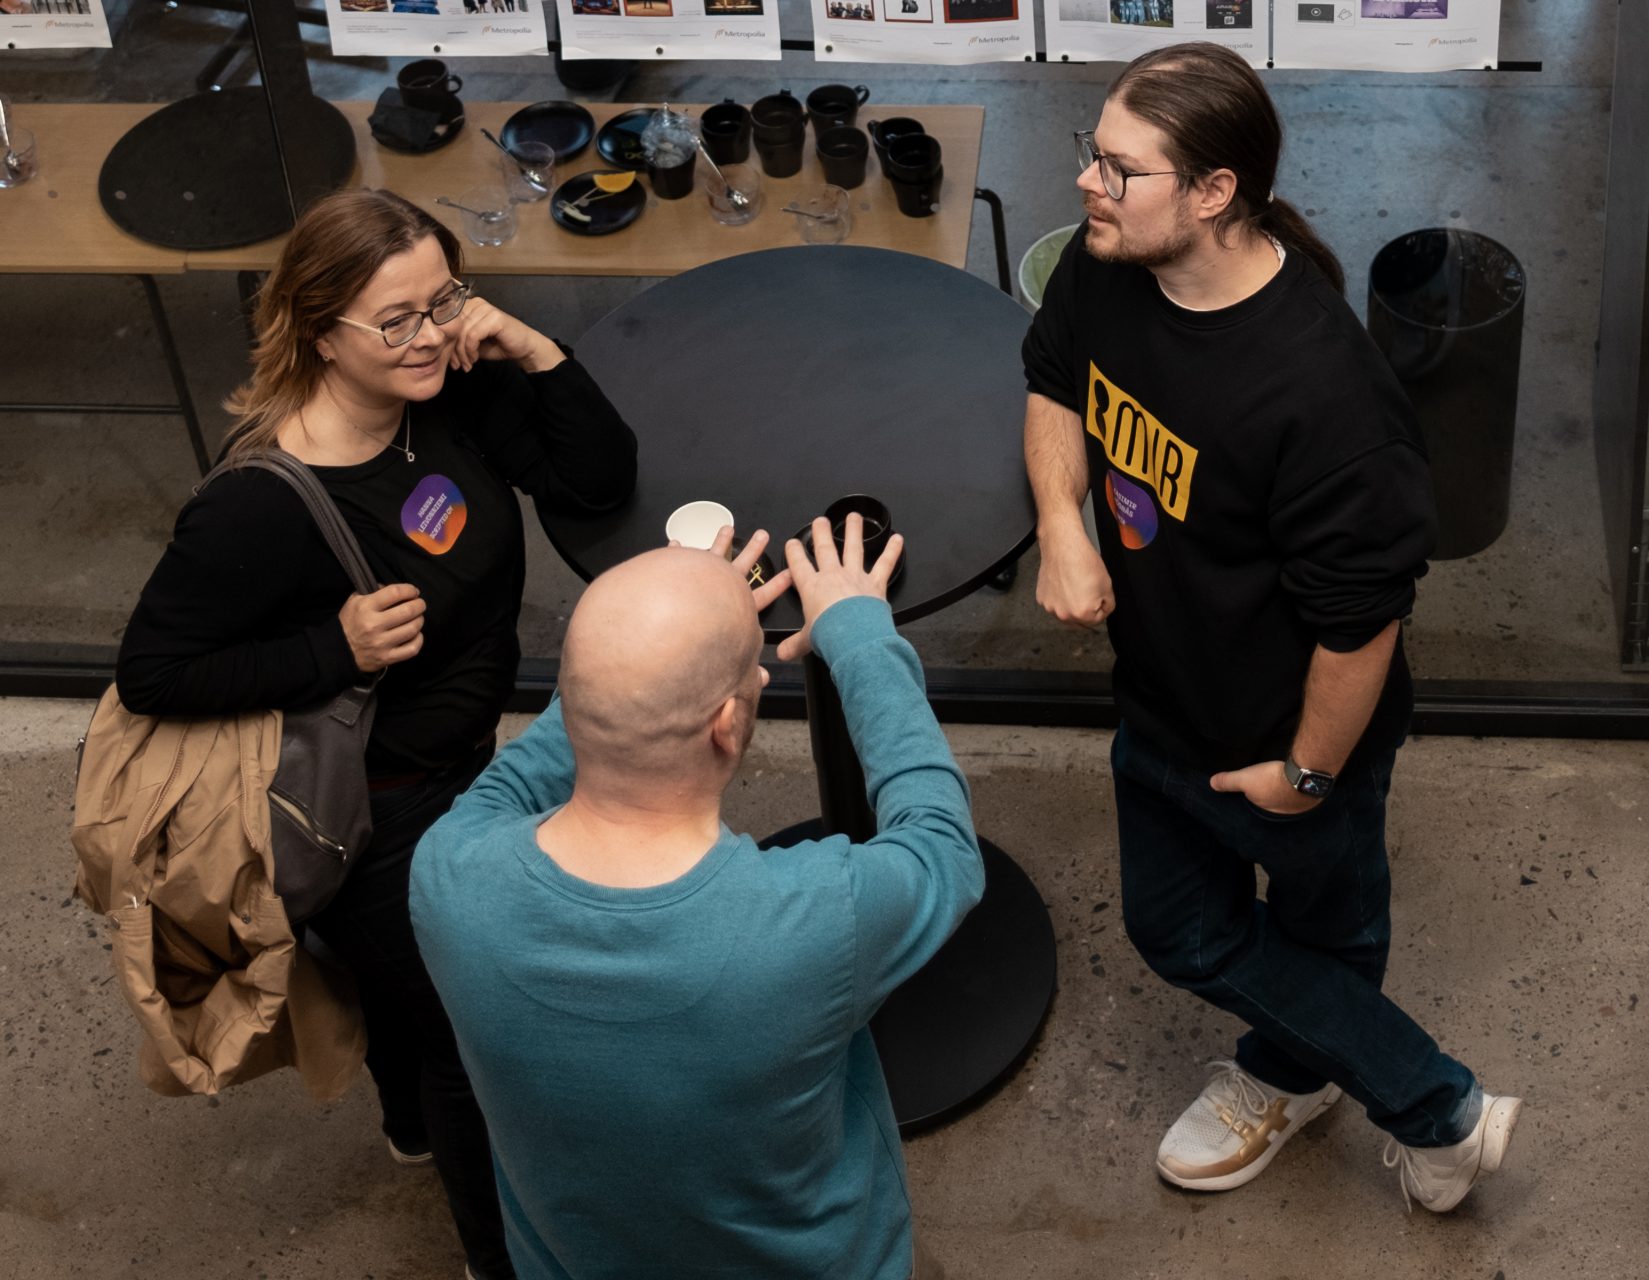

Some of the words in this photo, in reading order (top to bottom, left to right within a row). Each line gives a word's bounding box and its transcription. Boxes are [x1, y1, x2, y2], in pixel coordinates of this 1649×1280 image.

[491, 27, 532, 35] Metropolia
[724, 30, 766, 38] Metropolia
[978, 34, 1020, 44] Metropolia
[1438, 37, 1478, 45] Metropolia
[417, 496, 435, 518] HANNA
